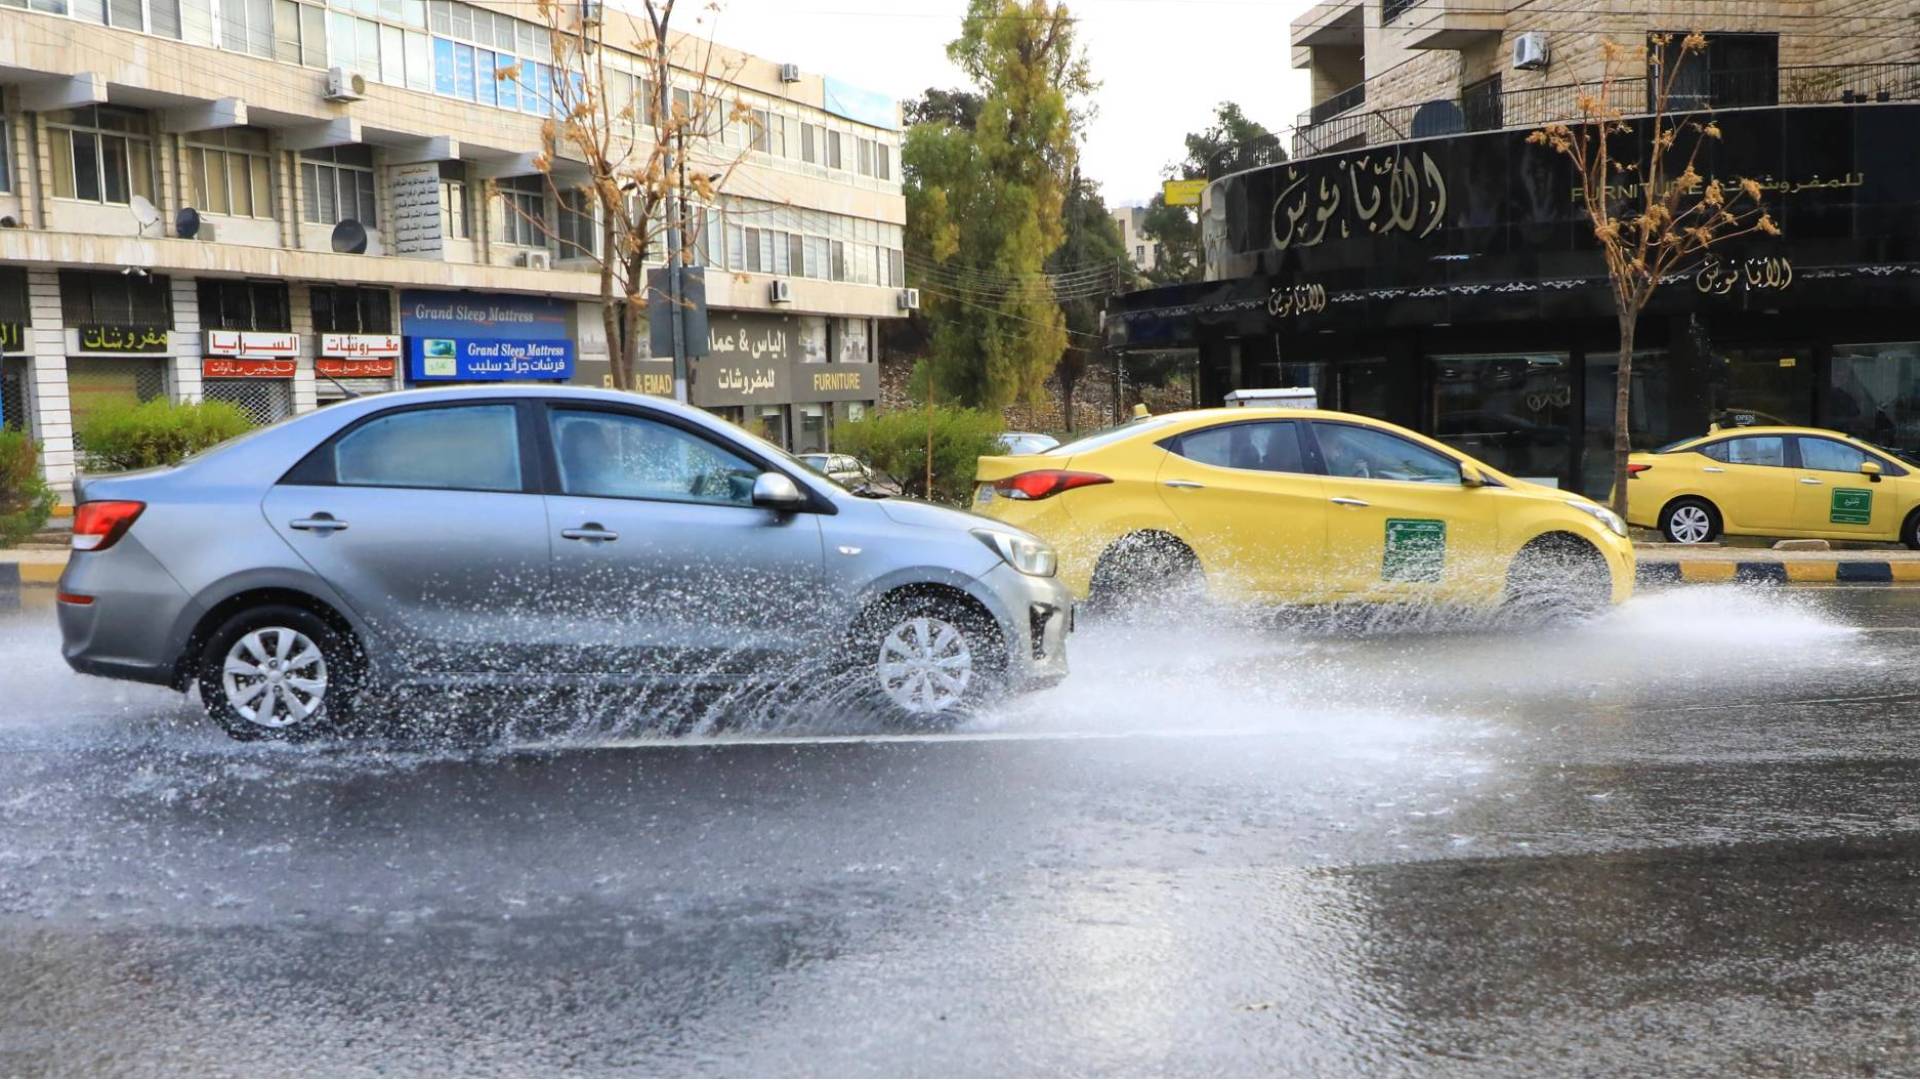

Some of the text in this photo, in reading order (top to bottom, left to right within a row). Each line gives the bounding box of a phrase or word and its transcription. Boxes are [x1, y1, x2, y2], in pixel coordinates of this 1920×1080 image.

[415, 304, 535, 323] Grand Sleep Mattress
[84, 327, 168, 349] مفروشات
[213, 333, 297, 353] السرايا
[327, 336, 398, 355] مفروشات
[739, 328, 750, 352] &
[467, 342, 565, 358] Grand Sleep Mattress
[468, 359, 565, 374] فرشات جراند سليب
[644, 374, 673, 394] EMAD
[718, 368, 775, 394] للمفروشات
[813, 373, 861, 391] FURNITURE
